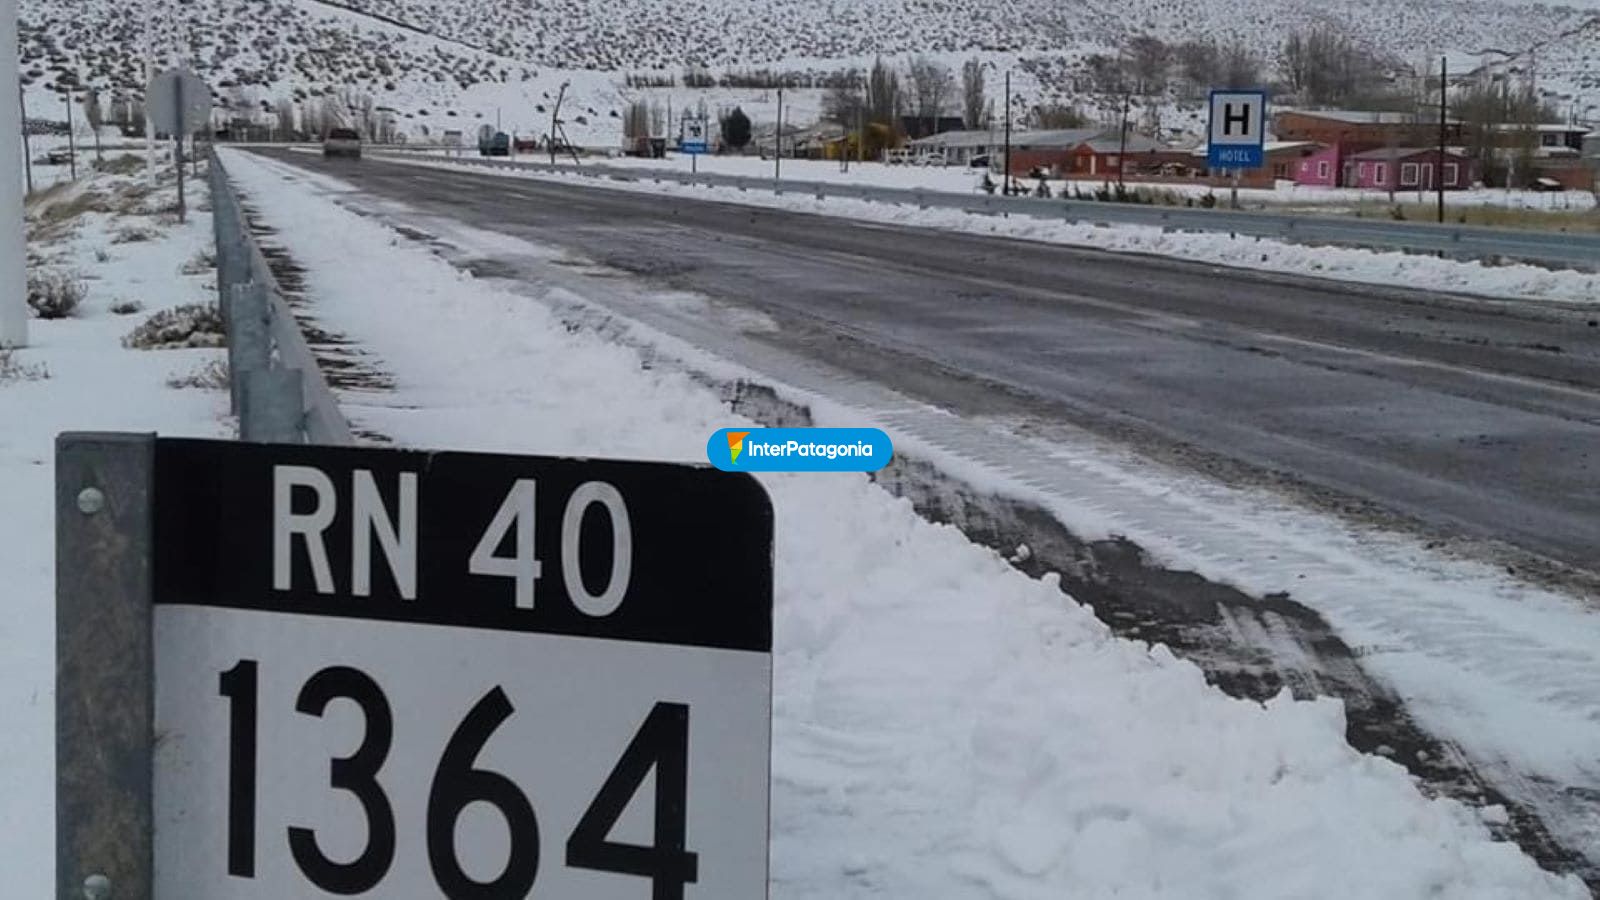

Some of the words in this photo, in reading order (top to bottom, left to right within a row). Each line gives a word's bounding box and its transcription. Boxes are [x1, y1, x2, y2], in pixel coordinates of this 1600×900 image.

[1219, 150, 1251, 162] HOTEL
[1224, 103, 1250, 135] H
[272, 464, 418, 601] RN
[468, 478, 633, 617] 40
[218, 658, 699, 900] 1364
